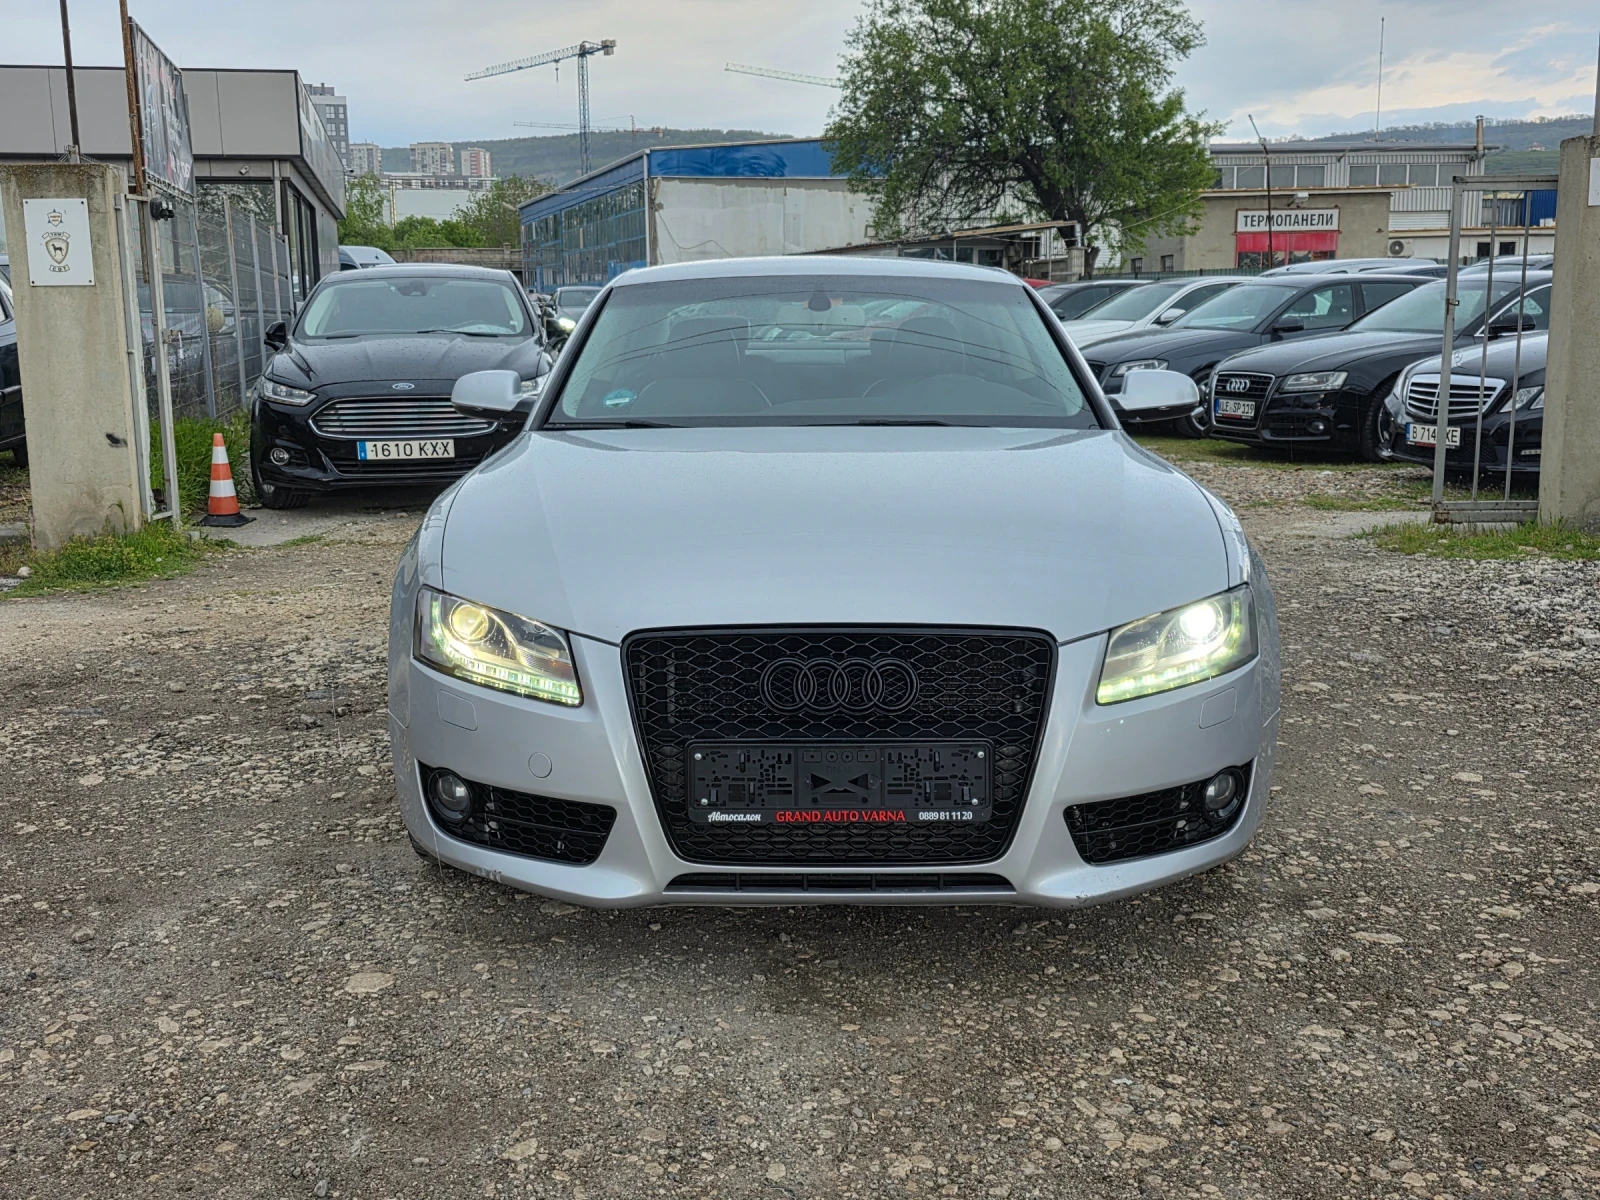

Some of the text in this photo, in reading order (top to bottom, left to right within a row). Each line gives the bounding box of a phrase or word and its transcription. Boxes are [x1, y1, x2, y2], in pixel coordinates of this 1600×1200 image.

[1243, 213, 1334, 228] ТЕРМОПАНЕЛИ
[372, 441, 450, 457] 1610 KXX
[708, 811, 761, 822] Автосалон
[776, 810, 906, 822] GRAND AUTO VARNA
